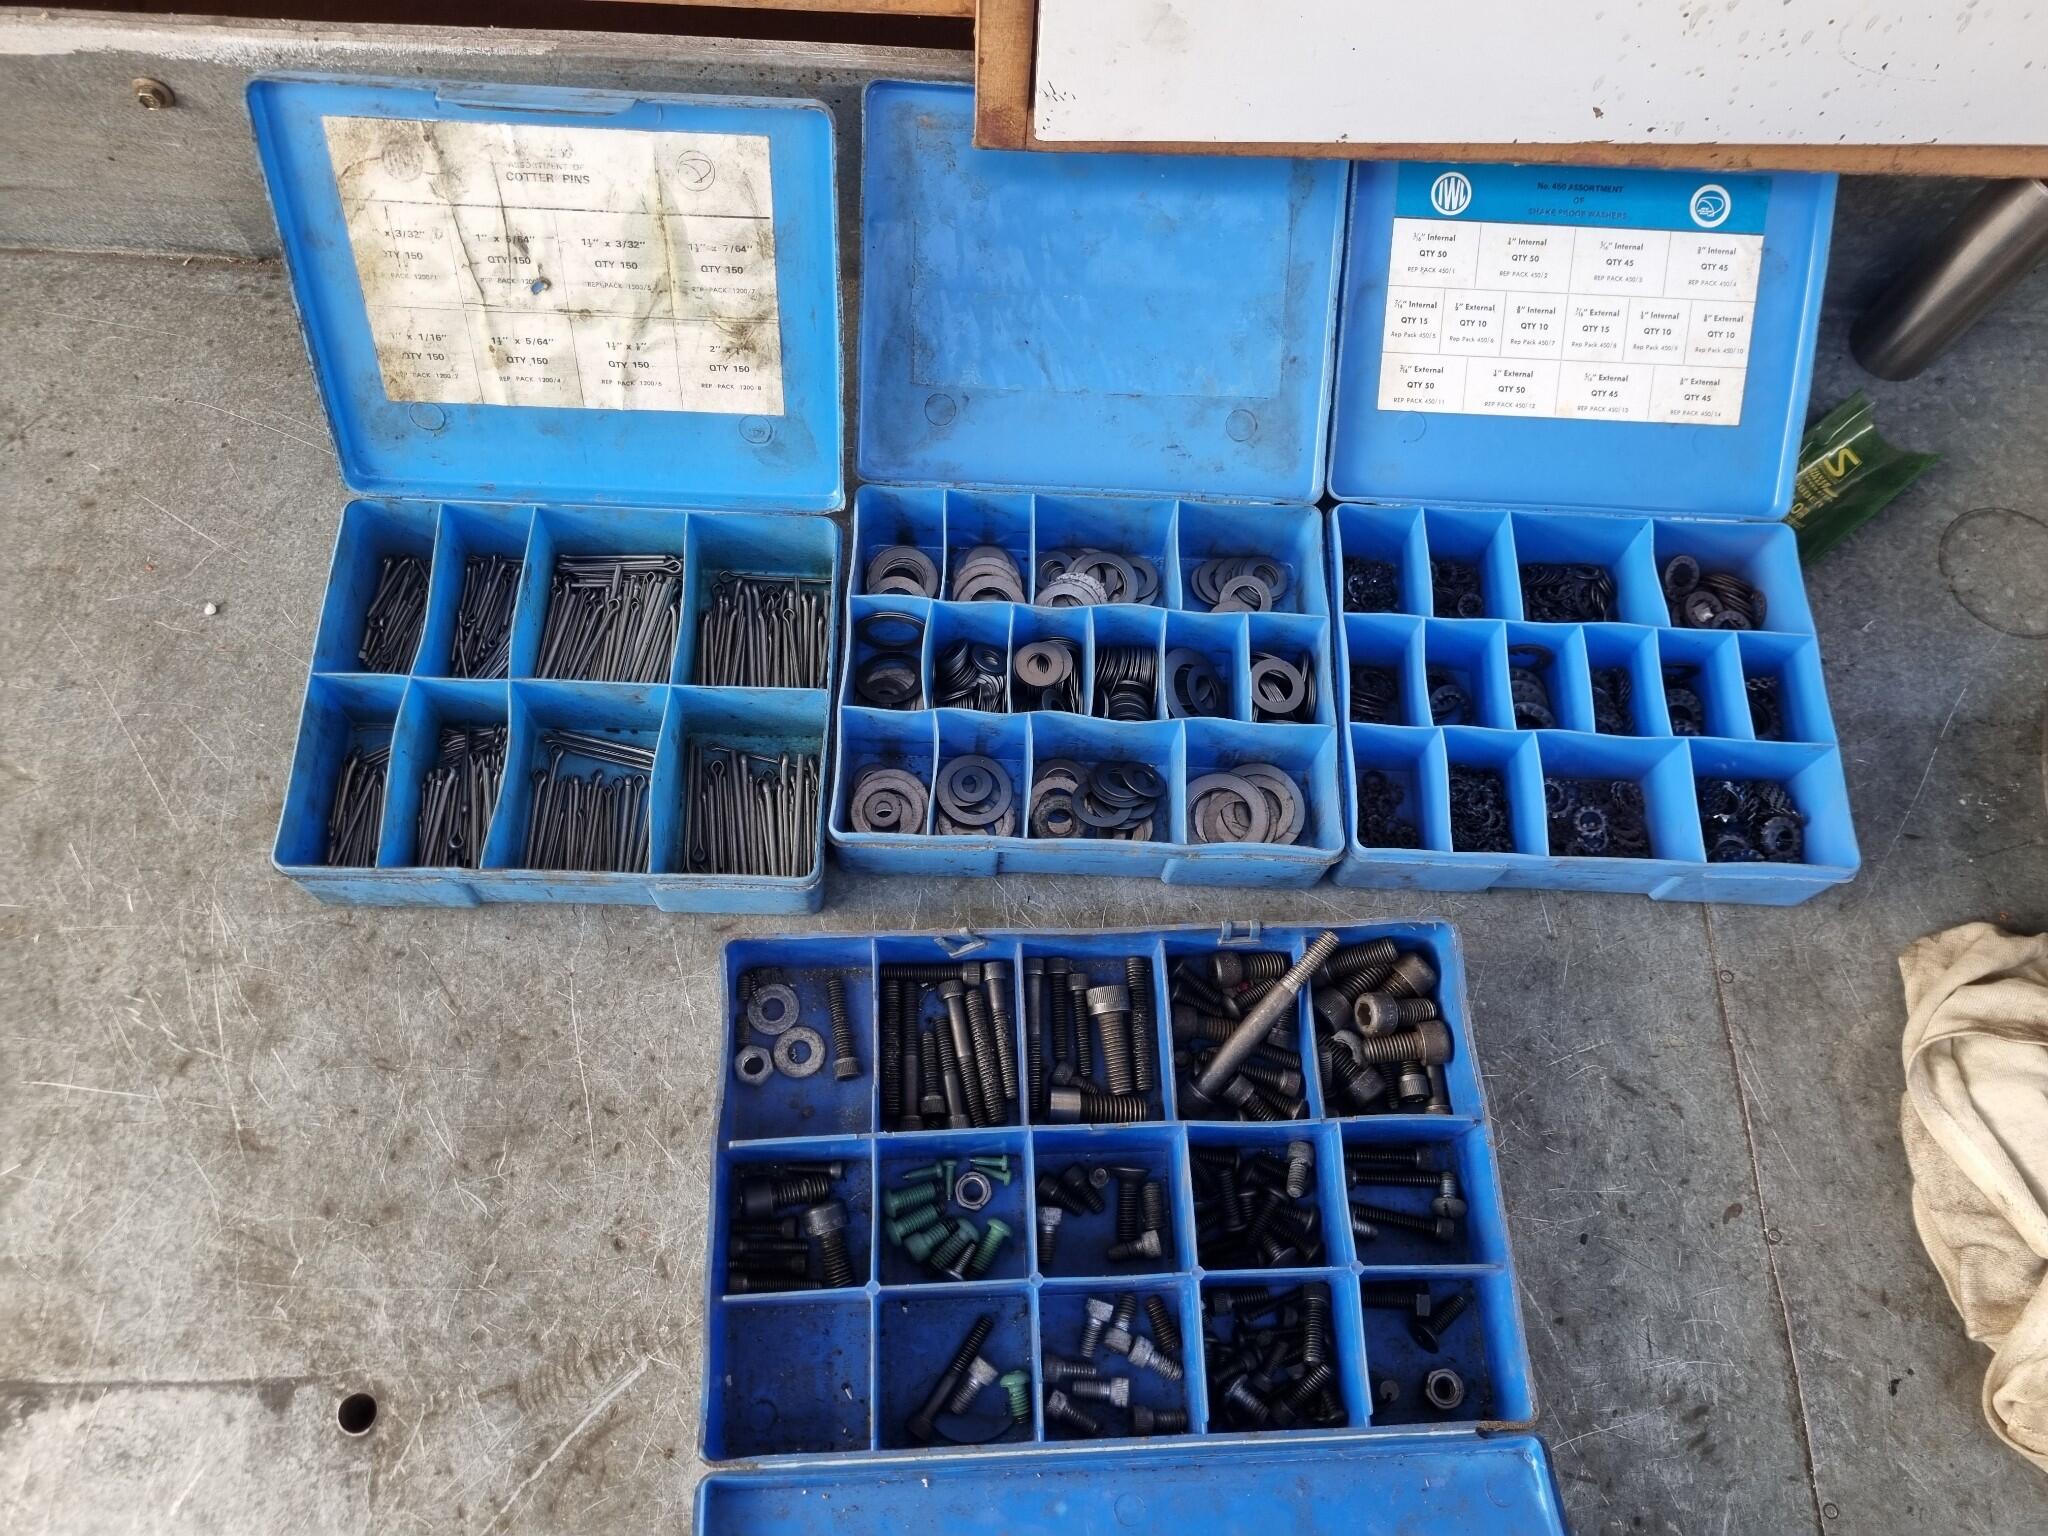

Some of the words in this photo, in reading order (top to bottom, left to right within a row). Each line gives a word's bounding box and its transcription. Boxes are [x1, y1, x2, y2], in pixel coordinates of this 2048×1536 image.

[505, 171, 554, 184] COTTER
[562, 174, 590, 184] PINS
[1567, 183, 1625, 194] ASSORTMENT
[1587, 209, 1628, 220] WASHERS
[1427, 232, 1457, 242] Internal
[1518, 237, 1548, 246] Internal
[615, 240, 646, 249] 3/32"
[1614, 241, 1644, 250] Internal
[1419, 249, 1435, 257] QTY
[1437, 250, 1448, 258] 50
[1707, 246, 1737, 255] Internal
[404, 251, 423, 260] 150
[487, 255, 508, 264] QTY
[512, 256, 531, 264] 150
[1511, 254, 1528, 262] QTY
[1530, 255, 1540, 263] 50
[594, 260, 615, 269] QTY
[620, 261, 638, 270] 150
[1606, 258, 1622, 266] QTY
[1624, 259, 1634, 267] 45
[700, 264, 721, 274] QTY
[726, 266, 744, 275] 150
[1701, 263, 1717, 271] QTY
[1718, 264, 1729, 272] 45
[1408, 301, 1438, 310] Internal
[1465, 303, 1496, 312] External
[1527, 306, 1556, 315] Internal
[1589, 308, 1620, 317] External
[1650, 311, 1680, 320] Internal
[1713, 315, 1744, 323] External
[1400, 316, 1416, 325] QTY
[1419, 317, 1428, 325] 15
[1459, 319, 1476, 327] QTY
[1520, 322, 1537, 330] QTY
[1540, 323, 1549, 331] 10
[1601, 325, 1610, 333] 15
[1643, 327, 1659, 335] QTY
[1662, 328, 1672, 336] 10
[1707, 330, 1723, 338] QTY
[1726, 331, 1736, 339] 10
[418, 333, 447, 342] 1/16"
[525, 337, 554, 346] 5/64"
[427, 353, 445, 361] 150
[506, 356, 526, 364] QTY
[531, 357, 549, 365] 150
[608, 360, 628, 369] QTY
[632, 361, 650, 369] 150
[709, 364, 729, 373] QTY
[733, 365, 750, 373] 150
[1414, 365, 1444, 375] External
[1503, 369, 1534, 378] External
[1598, 373, 1629, 382] External
[1690, 377, 1721, 386] External
[617, 380, 636, 388] PACK
[717, 383, 735, 391] PACK
[1407, 381, 1423, 389] QTY
[1425, 382, 1435, 390] 50
[1498, 385, 1514, 393] QTY
[1516, 386, 1526, 394] 50
[1591, 389, 1607, 397] QTY
[1608, 390, 1618, 398] 45
[1684, 393, 1700, 401] QTY
